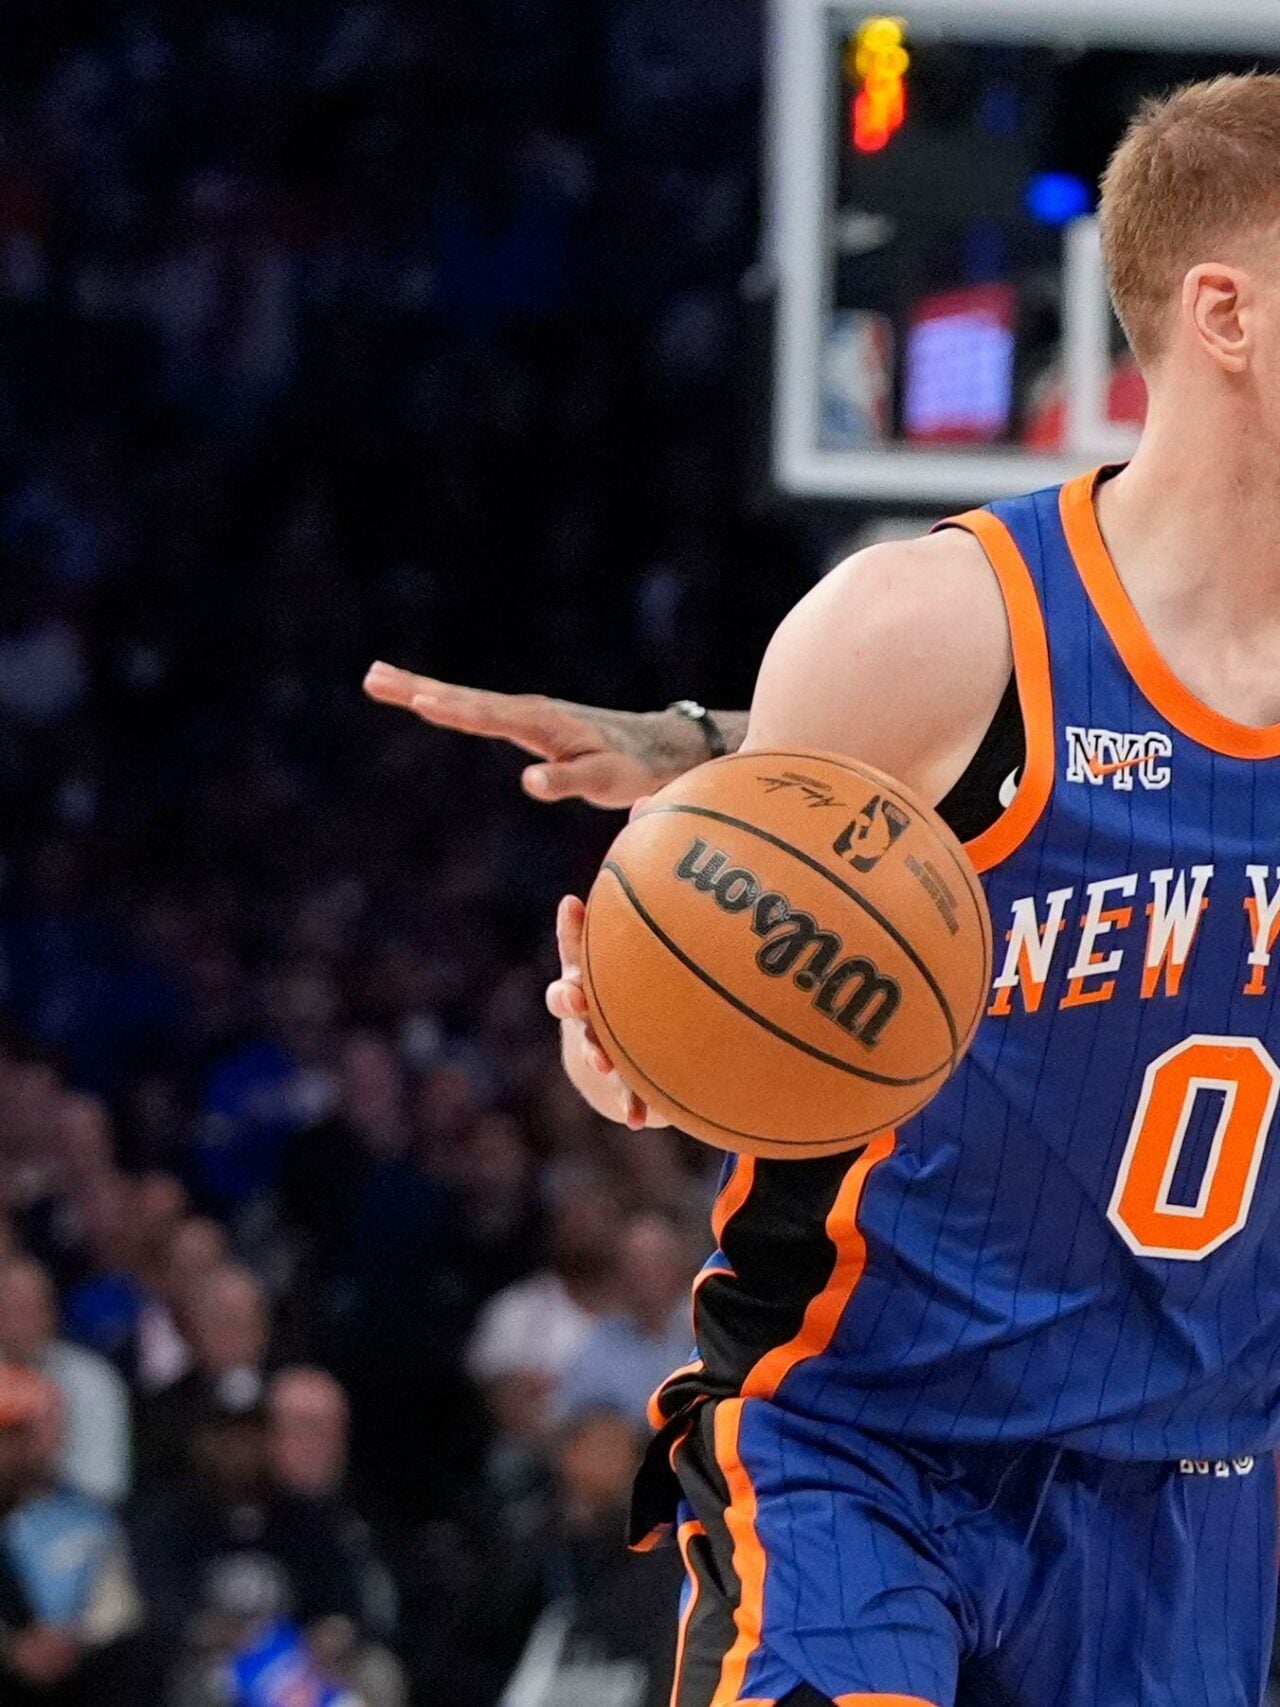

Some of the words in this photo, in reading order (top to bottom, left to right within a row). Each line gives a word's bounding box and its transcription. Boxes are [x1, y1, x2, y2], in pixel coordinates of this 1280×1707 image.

[1066, 726, 1172, 791] NYC
[674, 837, 902, 1052] Wilson
[987, 864, 1214, 1016] NEW
